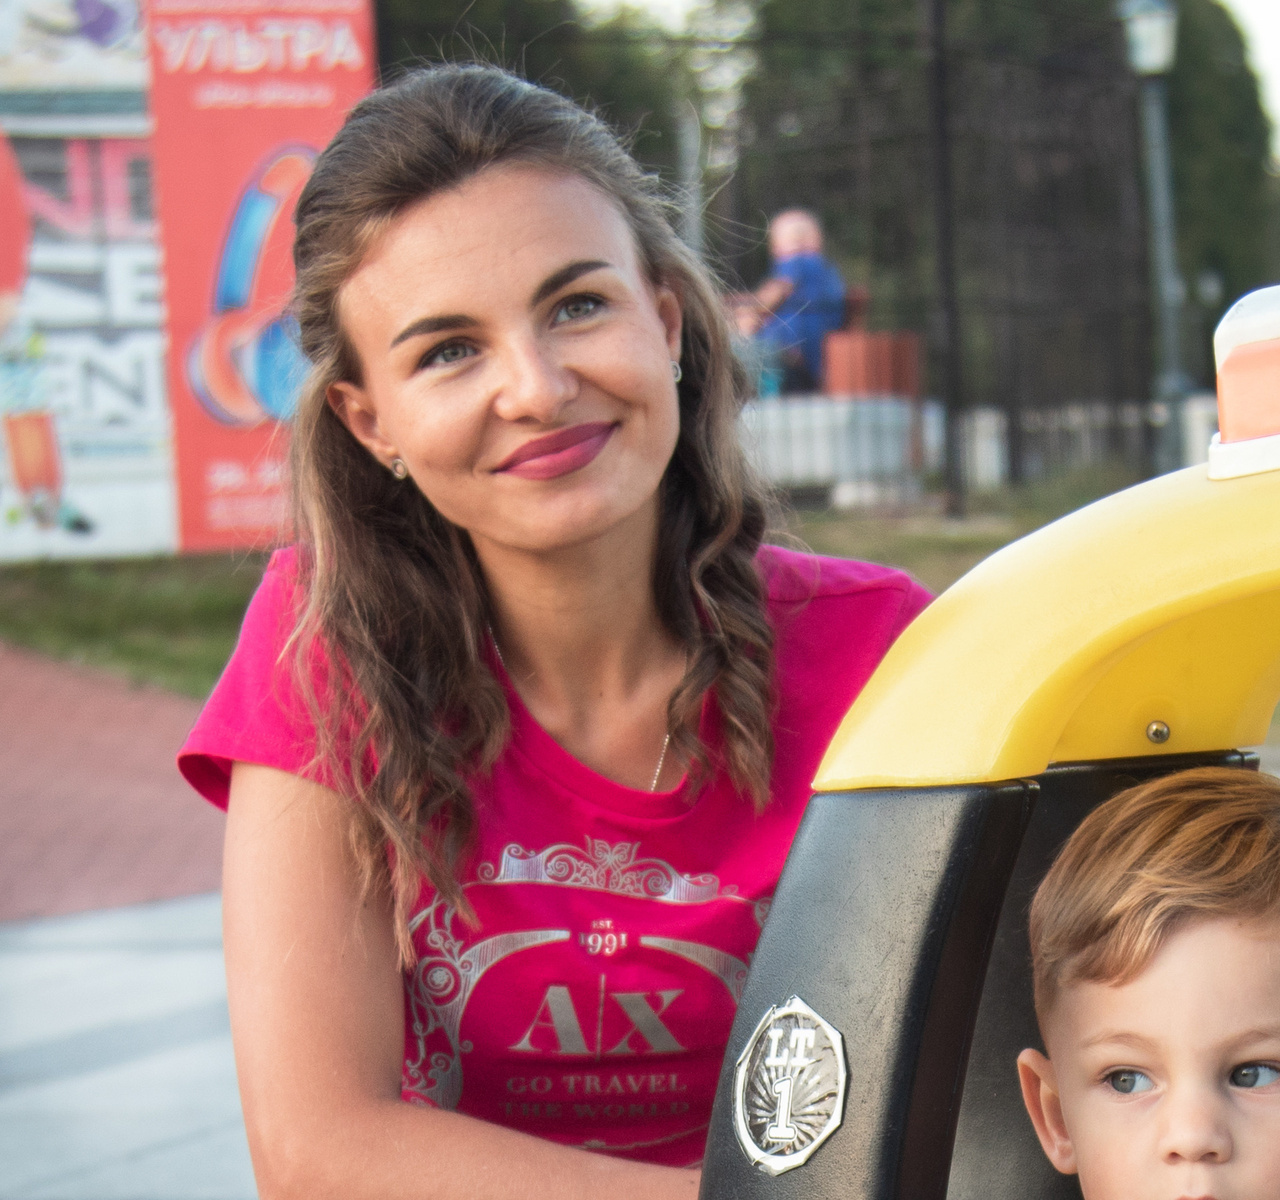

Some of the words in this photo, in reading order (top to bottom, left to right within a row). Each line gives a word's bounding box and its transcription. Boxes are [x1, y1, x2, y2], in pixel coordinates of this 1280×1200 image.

[155, 21, 363, 71] УЛЬТРА
[766, 1028, 815, 1067] LT
[506, 1075, 552, 1093] GO
[563, 1074, 687, 1094] TRAVEL
[767, 1075, 797, 1141] 1
